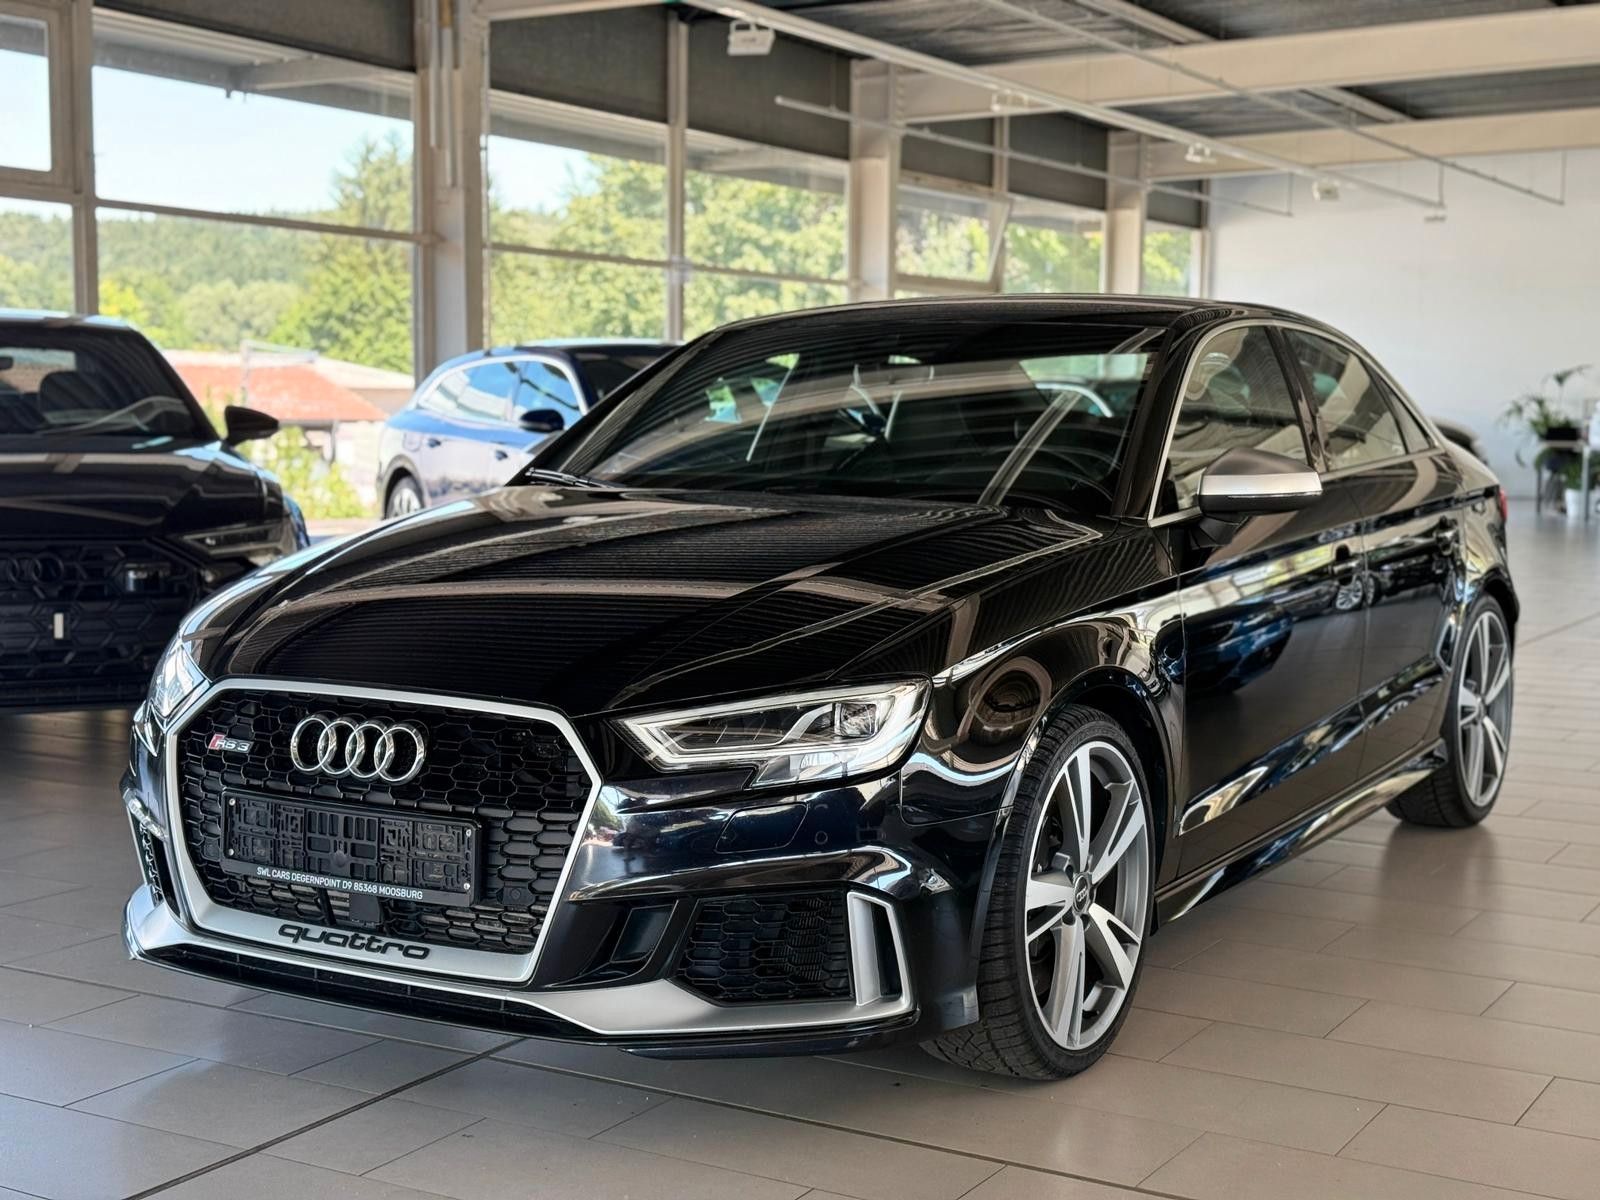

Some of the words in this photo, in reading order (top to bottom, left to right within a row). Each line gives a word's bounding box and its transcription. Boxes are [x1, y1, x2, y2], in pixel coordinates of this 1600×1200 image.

[256, 866, 271, 877] SWL
[271, 869, 291, 880] CARS
[291, 872, 341, 888] DEGERNPOINT
[342, 880, 353, 889] D9
[353, 882, 378, 894] 85368
[378, 885, 423, 899] MOOSBURG
[278, 923, 430, 960] quattro
